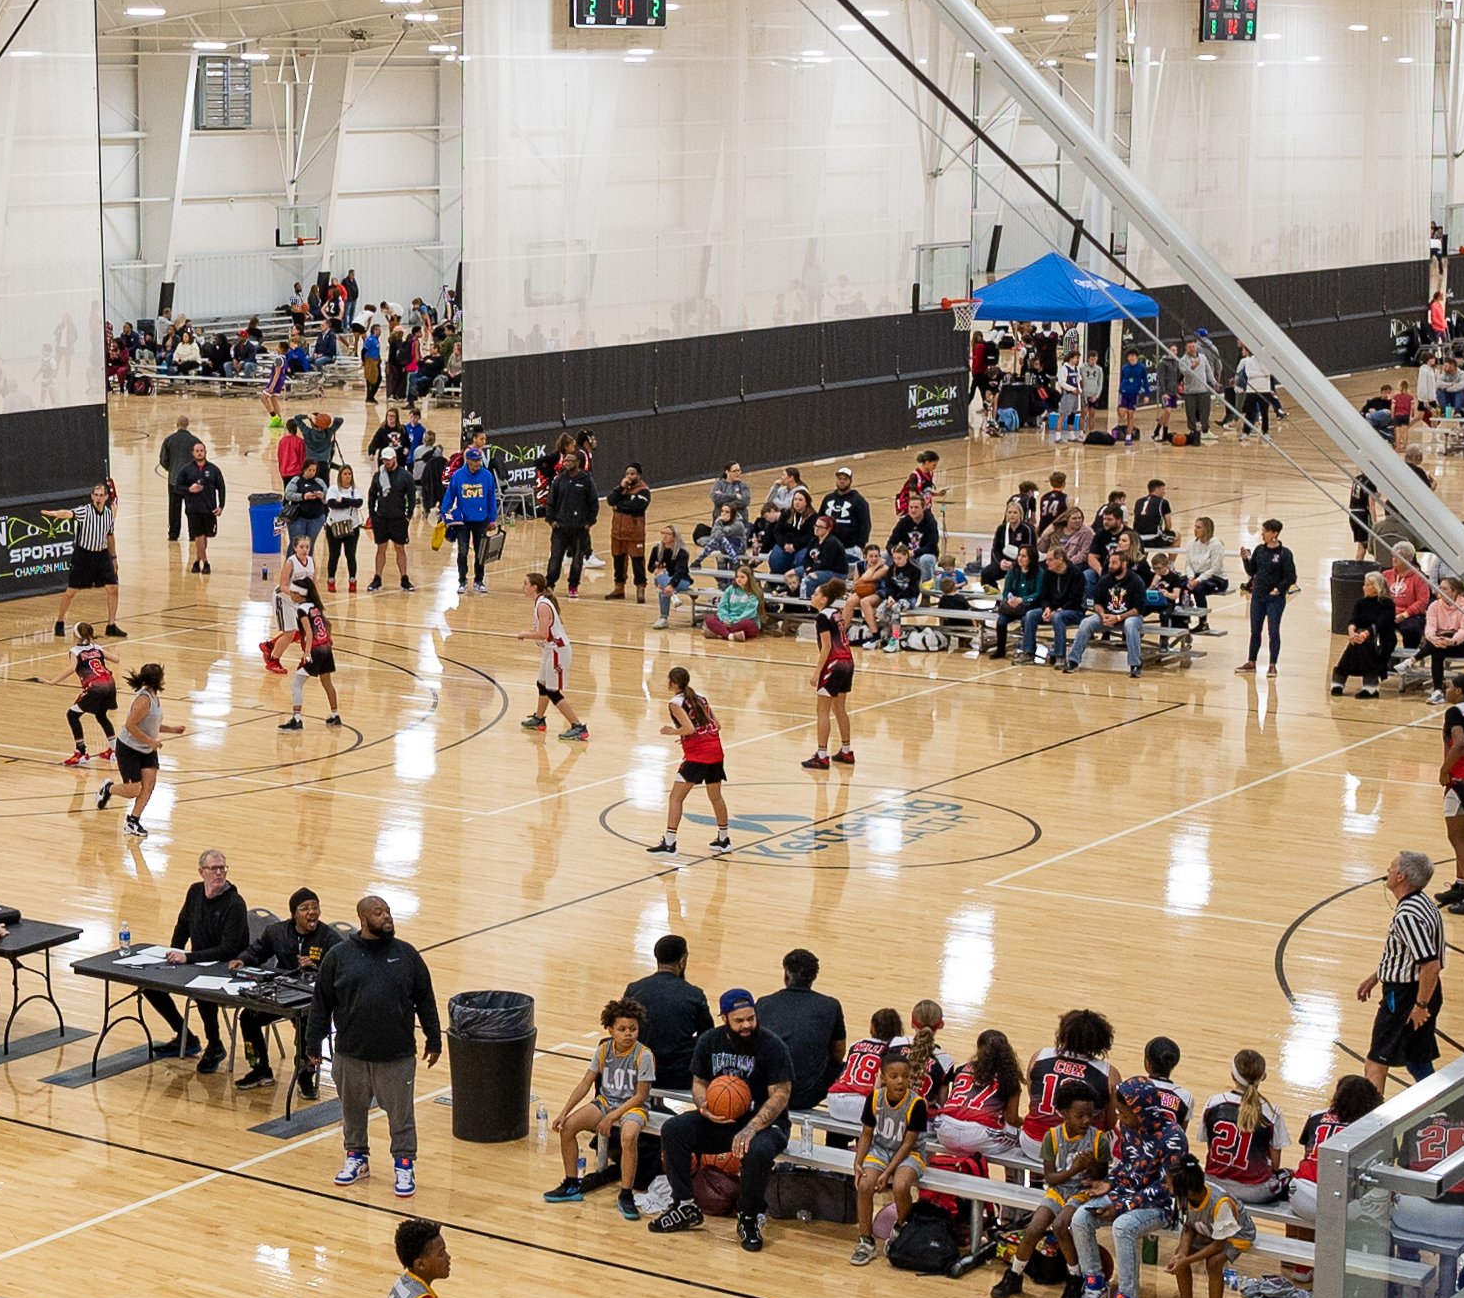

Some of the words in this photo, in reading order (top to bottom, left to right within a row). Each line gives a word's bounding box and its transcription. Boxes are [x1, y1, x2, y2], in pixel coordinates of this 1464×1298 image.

[652, 0, 660, 17] 2
[329, 301, 335, 314] 2
[916, 404, 950, 419] SPORTS
[1041, 500, 1060, 517] 34
[1140, 500, 1149, 516] 1
[9, 541, 74, 563] SPORTS
[14, 564, 53, 578] CHAMPION
[53, 561, 70, 573] MILL
[839, 1052, 882, 1087] 18
[1054, 1059, 1087, 1078] COX
[1210, 1120, 1254, 1171] 21
